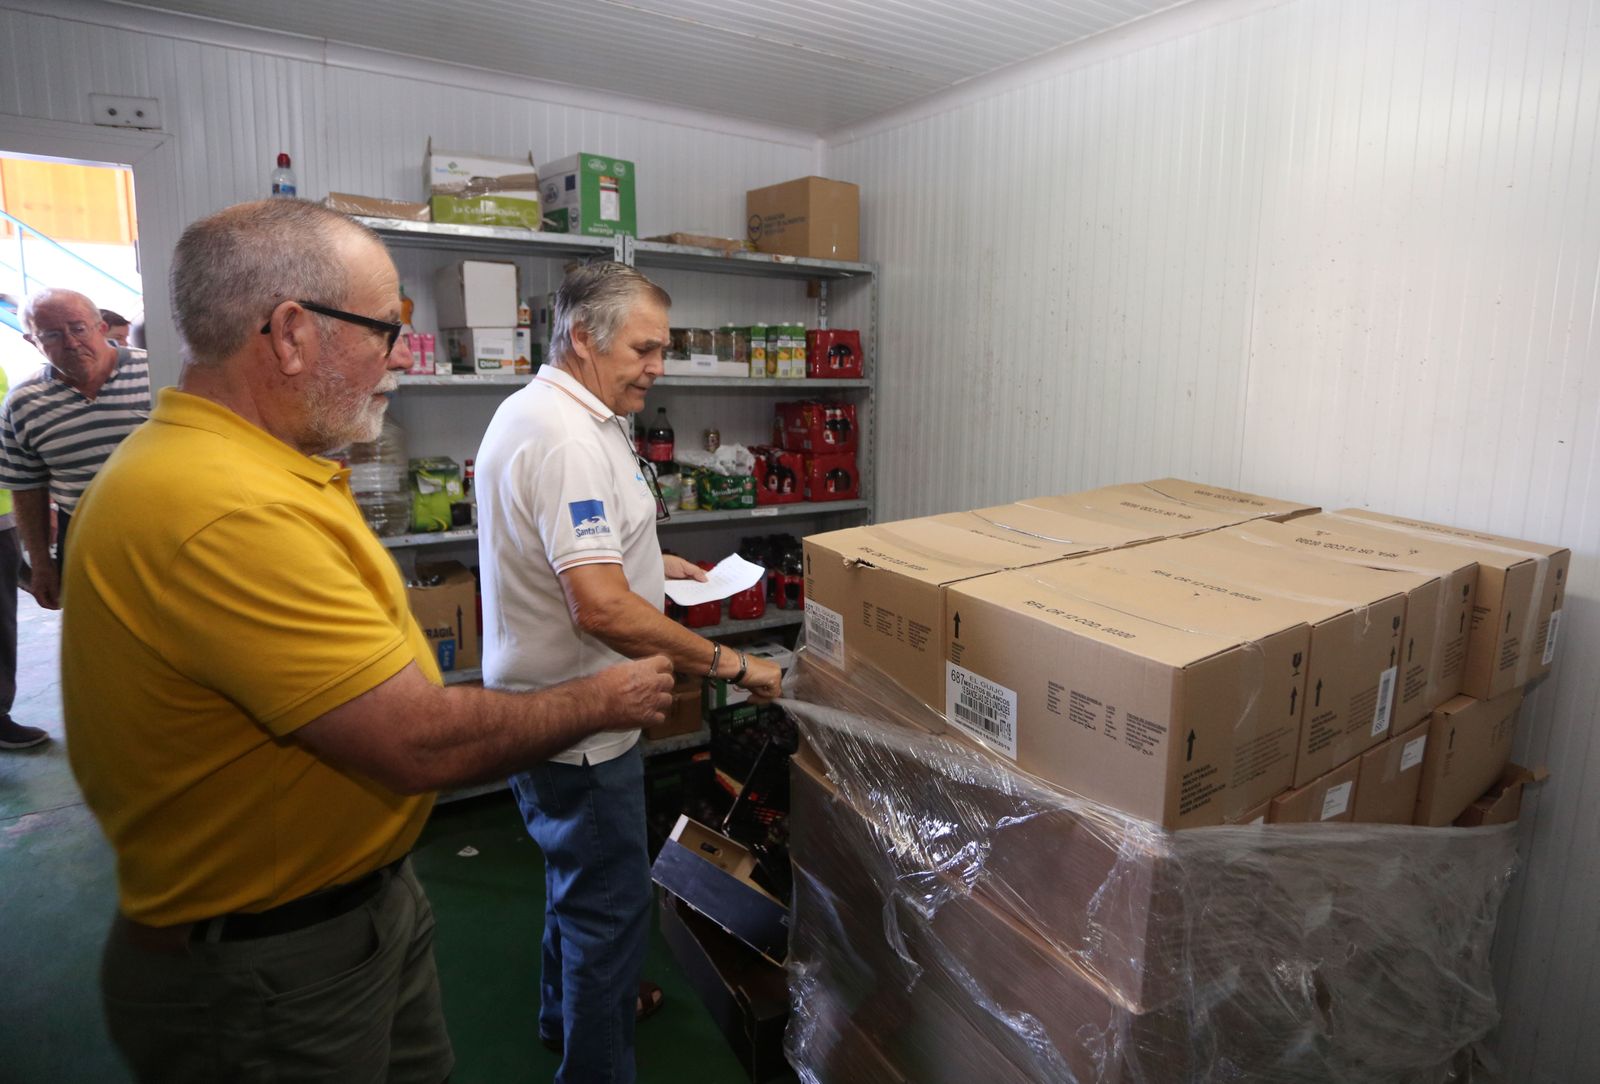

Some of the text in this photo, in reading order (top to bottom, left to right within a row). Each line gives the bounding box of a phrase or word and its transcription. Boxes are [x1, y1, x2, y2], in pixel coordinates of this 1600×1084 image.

[575, 527, 596, 538] Santa
[950, 669, 965, 685] 687
[969, 675, 1004, 697] EL GUIJO
[986, 691, 1010, 707] BLANCOS
